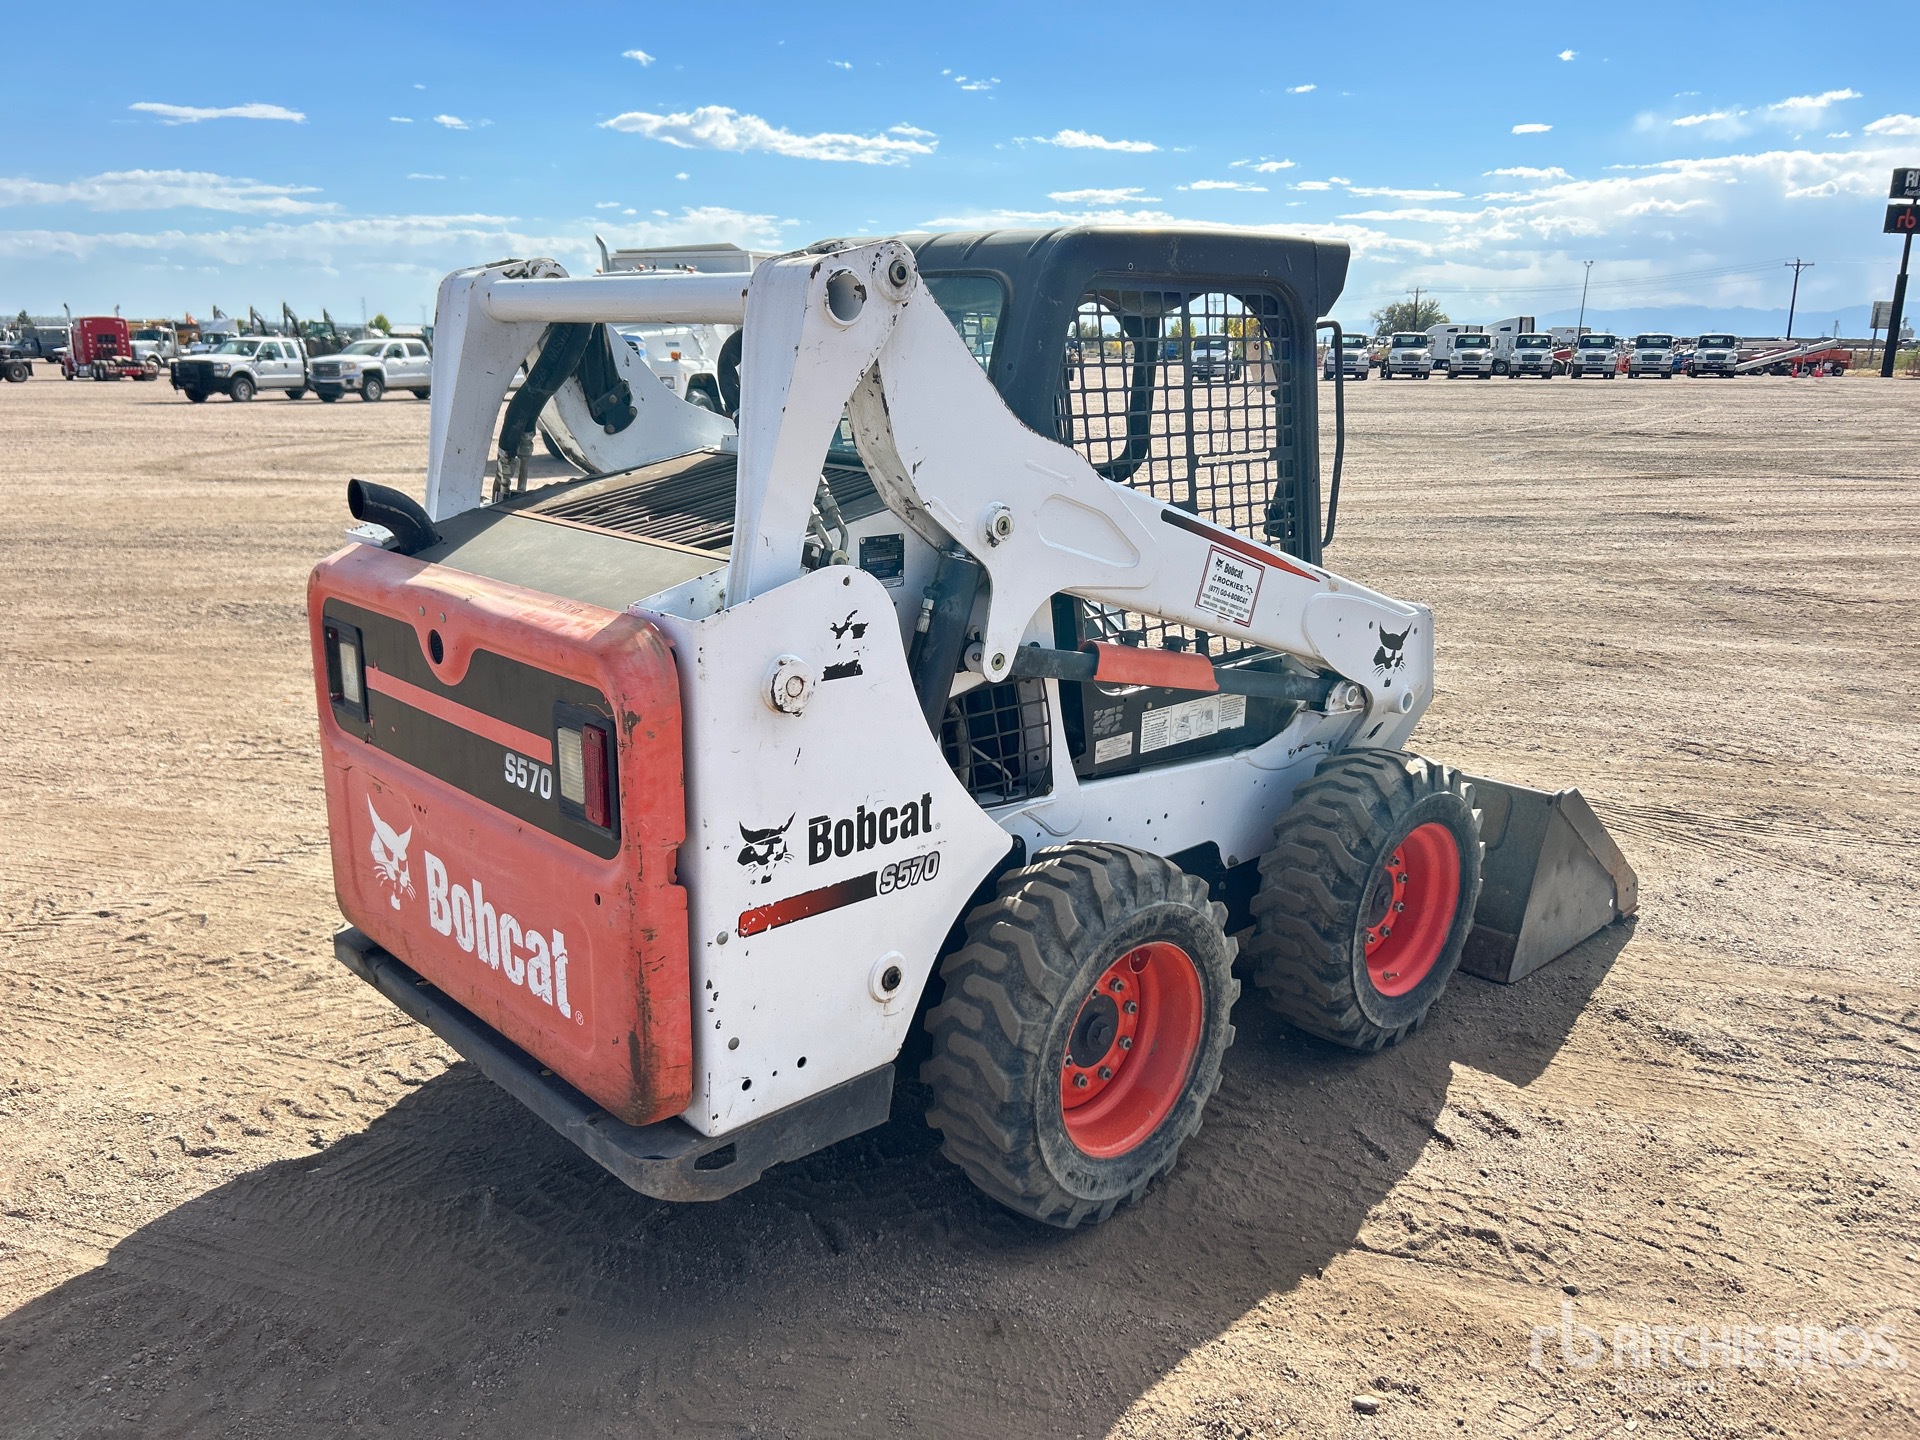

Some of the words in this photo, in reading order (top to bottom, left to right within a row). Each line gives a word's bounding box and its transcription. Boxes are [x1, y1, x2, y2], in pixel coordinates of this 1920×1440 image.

[1896, 207, 1917, 229] rb
[1216, 575, 1245, 592] ROCKIES
[1224, 562, 1244, 580] Bobcat
[1208, 584, 1220, 596] (877)
[504, 752, 553, 800] S570
[808, 792, 933, 866] Bobcat
[879, 850, 941, 895] S570
[423, 849, 572, 1019] Bobcat
